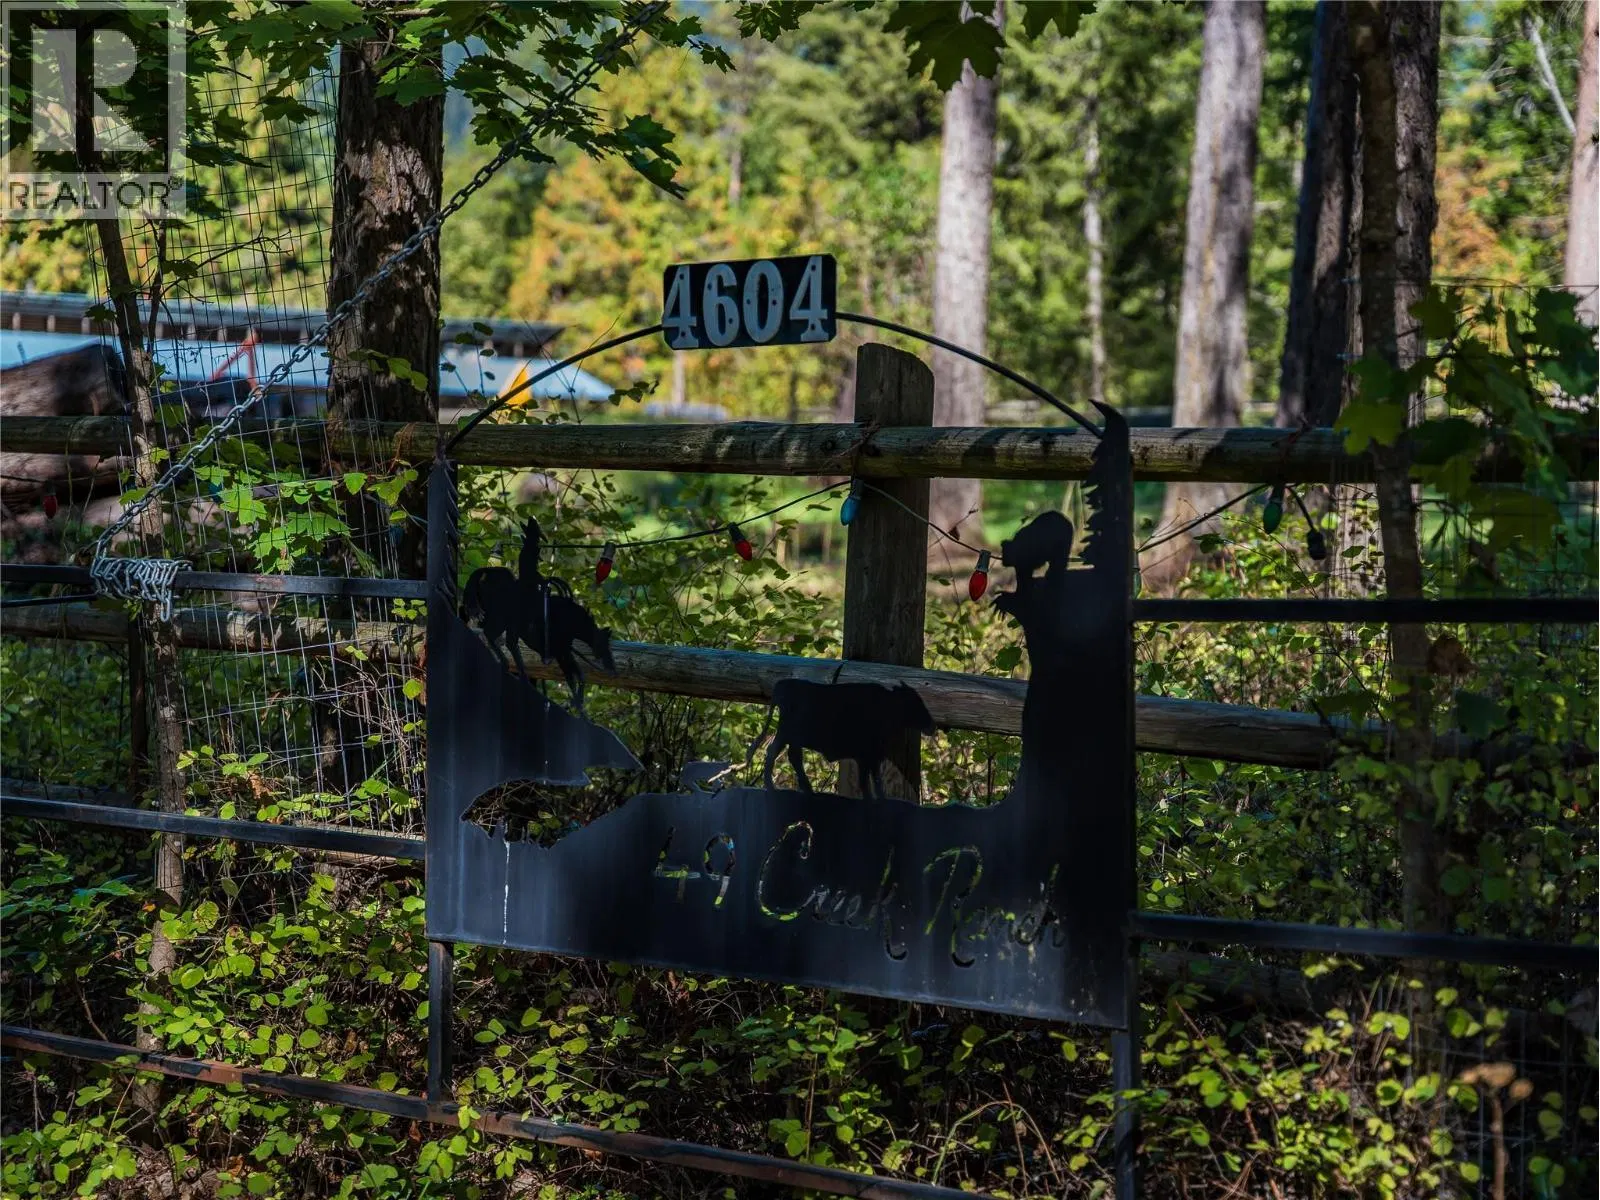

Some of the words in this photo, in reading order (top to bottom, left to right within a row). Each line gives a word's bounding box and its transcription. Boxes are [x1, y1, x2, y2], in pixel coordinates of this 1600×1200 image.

[662, 255, 829, 349] 4604
[652, 826, 736, 906] 49
[757, 819, 907, 960] Creek
